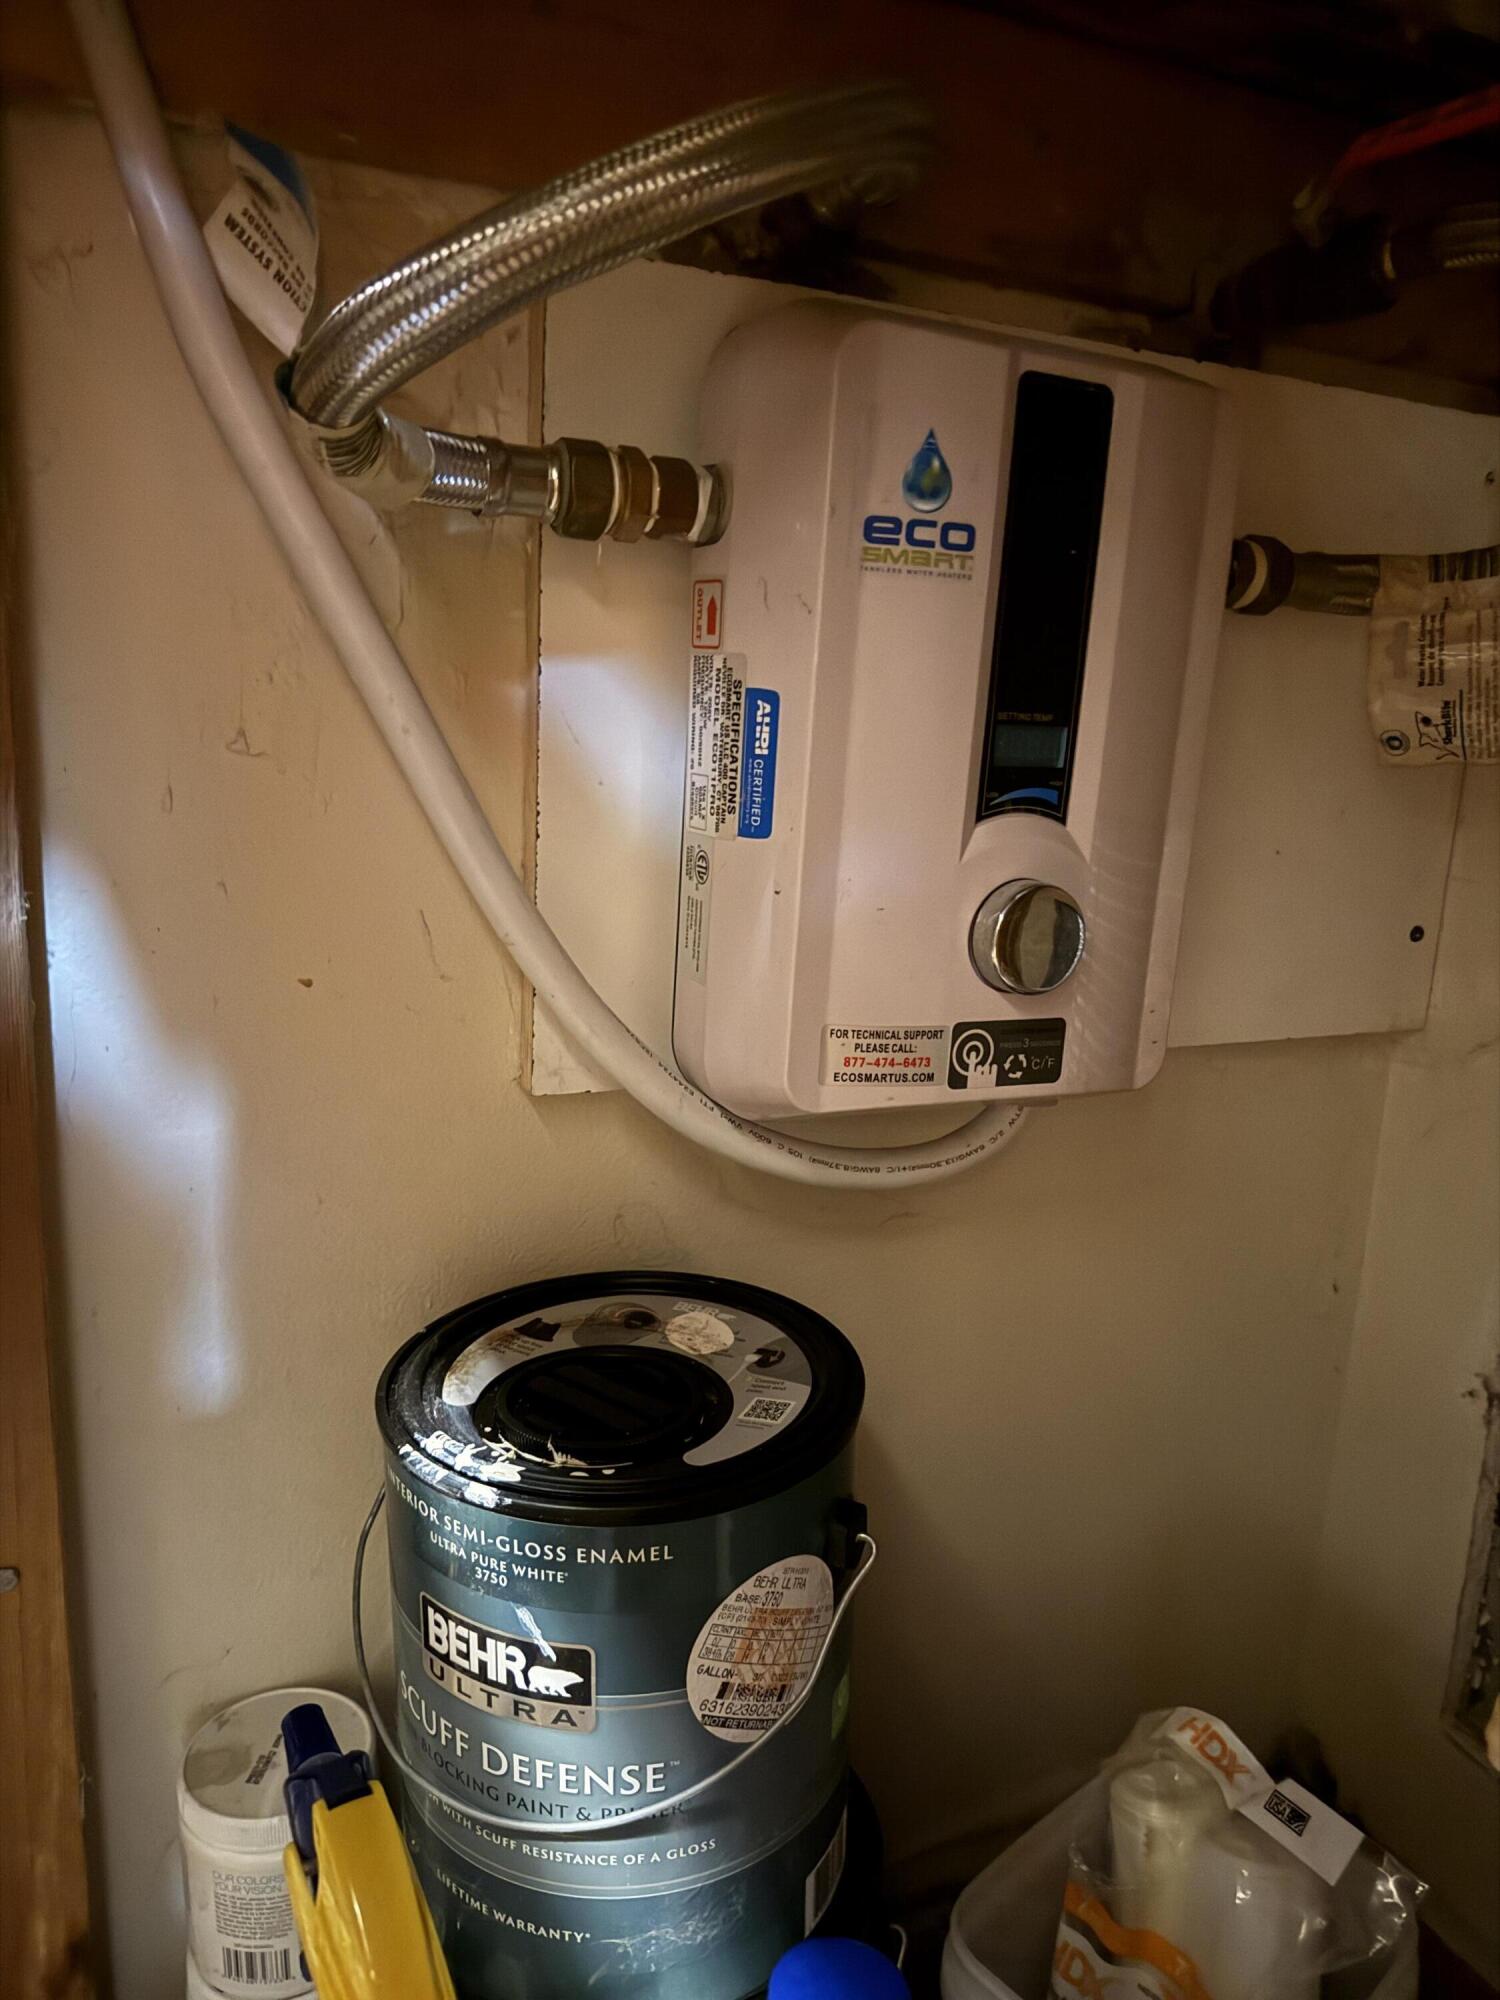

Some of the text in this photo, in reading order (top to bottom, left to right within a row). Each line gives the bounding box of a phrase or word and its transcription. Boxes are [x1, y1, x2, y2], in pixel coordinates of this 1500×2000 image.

[224, 213, 273, 270] SYSTEM
[864, 515, 975, 552] eco
[695, 588, 704, 640] OUTLET
[713, 668, 721, 726] MODEL
[727, 680, 742, 815] SPECIFICATIONS
[751, 700, 771, 826] AHRI CERTIFIED
[720, 783, 728, 824] CAPTAIN
[830, 1028, 944, 1040] FOR TECHNICAL SUPPORT
[854, 1043, 917, 1053] PLEASE CALL:
[1023, 1038, 1029, 1048] 3
[833, 1072, 935, 1083] ECOSMARTUS.COM
[844, 1056, 931, 1069] 877-474-6473
[430, 1531, 467, 1561] ULTRA
[471, 1551, 508, 1573] PURE
[444, 1515, 567, 1563] SEMI-GLOSS
[577, 1545, 674, 1564] ENAMEL
[475, 1567, 508, 1587] 3750
[754, 1576, 779, 1589] BEHR
[428, 1605, 530, 1691] BEHR
[430, 1659, 579, 1727] ULTRA
[699, 1699, 792, 1717] 63162390243
[399, 1669, 667, 1796] SCUFF DEFENSE
[703, 1717, 776, 1729] NOT RETURNAB
[1177, 1716, 1250, 1786] HDX
[507, 1792, 569, 1820] PAINT
[576, 1806, 592, 1822] &
[442, 1802, 717, 1867] WITH SCUFF RESISTANCE OF A GLOSS
[215, 1882, 282, 1895] YOUR VISION
[236, 1874, 285, 1885] COLORS
[436, 1868, 489, 1915] LIFETIME
